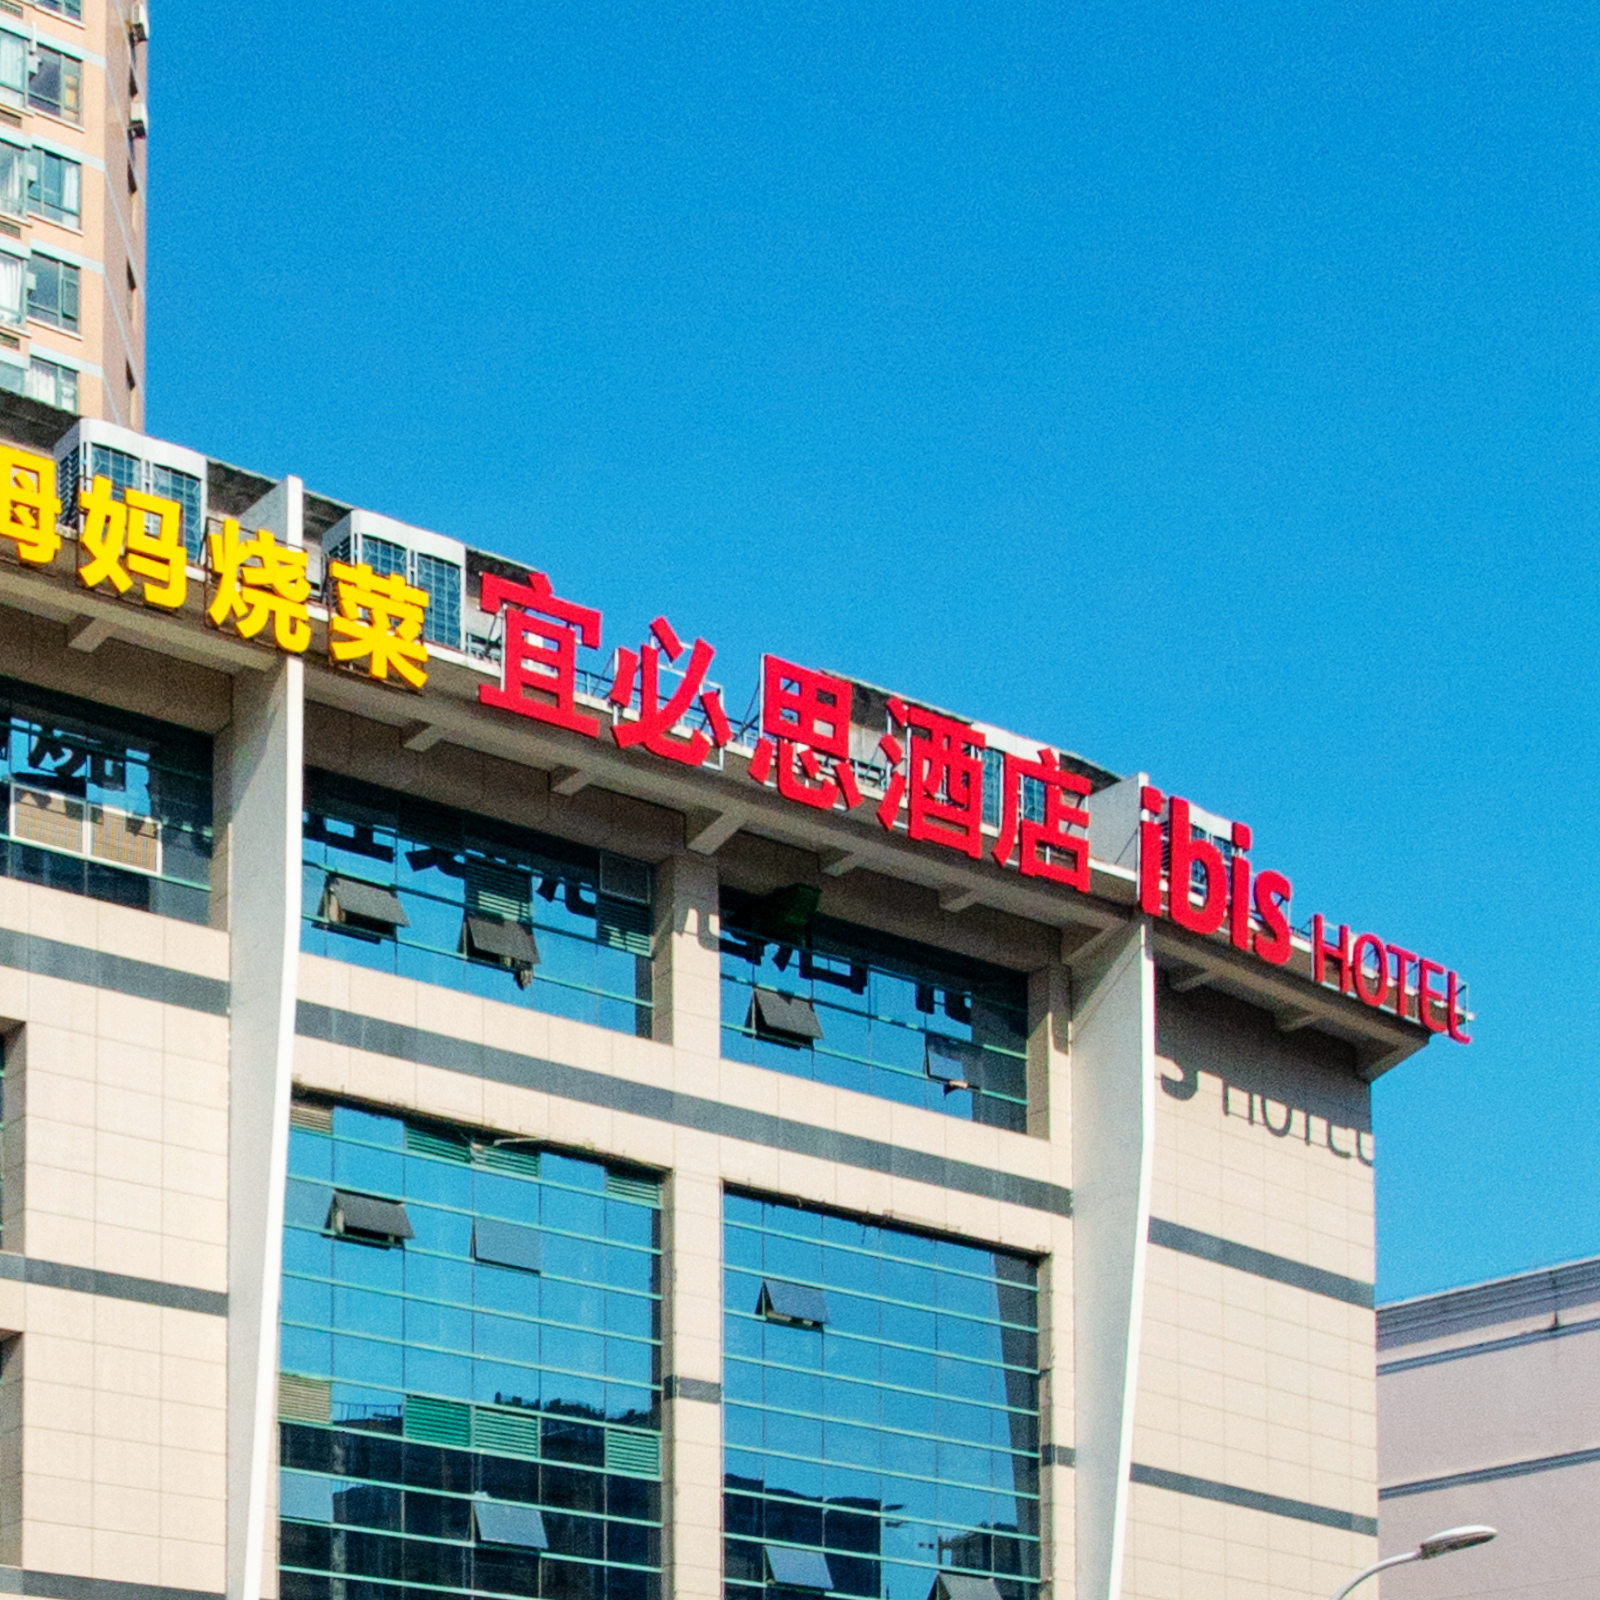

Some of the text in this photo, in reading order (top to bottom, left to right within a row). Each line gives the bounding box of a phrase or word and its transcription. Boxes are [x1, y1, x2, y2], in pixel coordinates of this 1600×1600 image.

[479, 572, 1092, 893] 宜必思酒店
[1140, 786, 1471, 1045] ibis HOTEL
